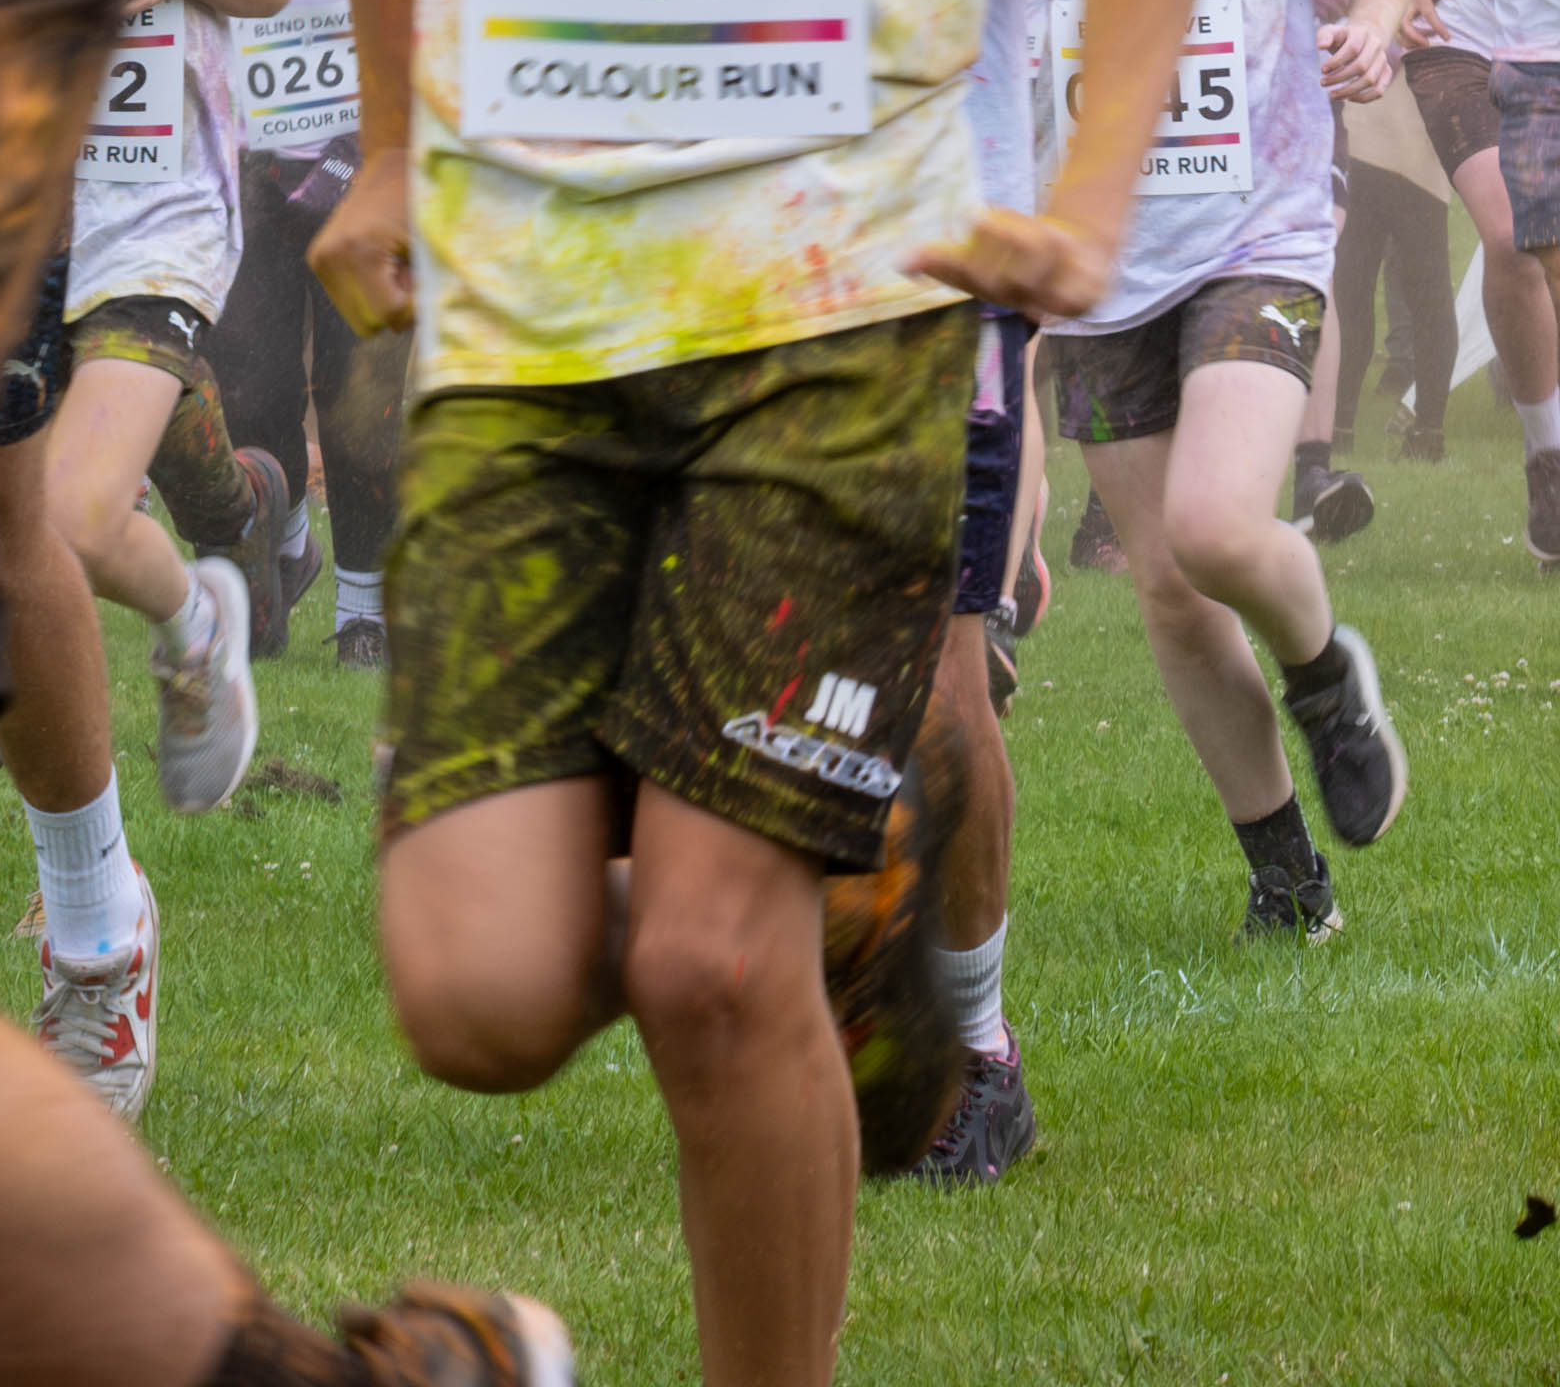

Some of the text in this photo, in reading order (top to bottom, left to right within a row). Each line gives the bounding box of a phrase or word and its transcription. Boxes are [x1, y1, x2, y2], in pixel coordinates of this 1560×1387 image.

[254, 18, 305, 38] BLIND
[508, 57, 822, 102] COLOUR RUN
[263, 106, 362, 137] COLOUR RU
[107, 146, 158, 164] RUN
[1178, 155, 1228, 175] RUN
[804, 671, 878, 739] JM
